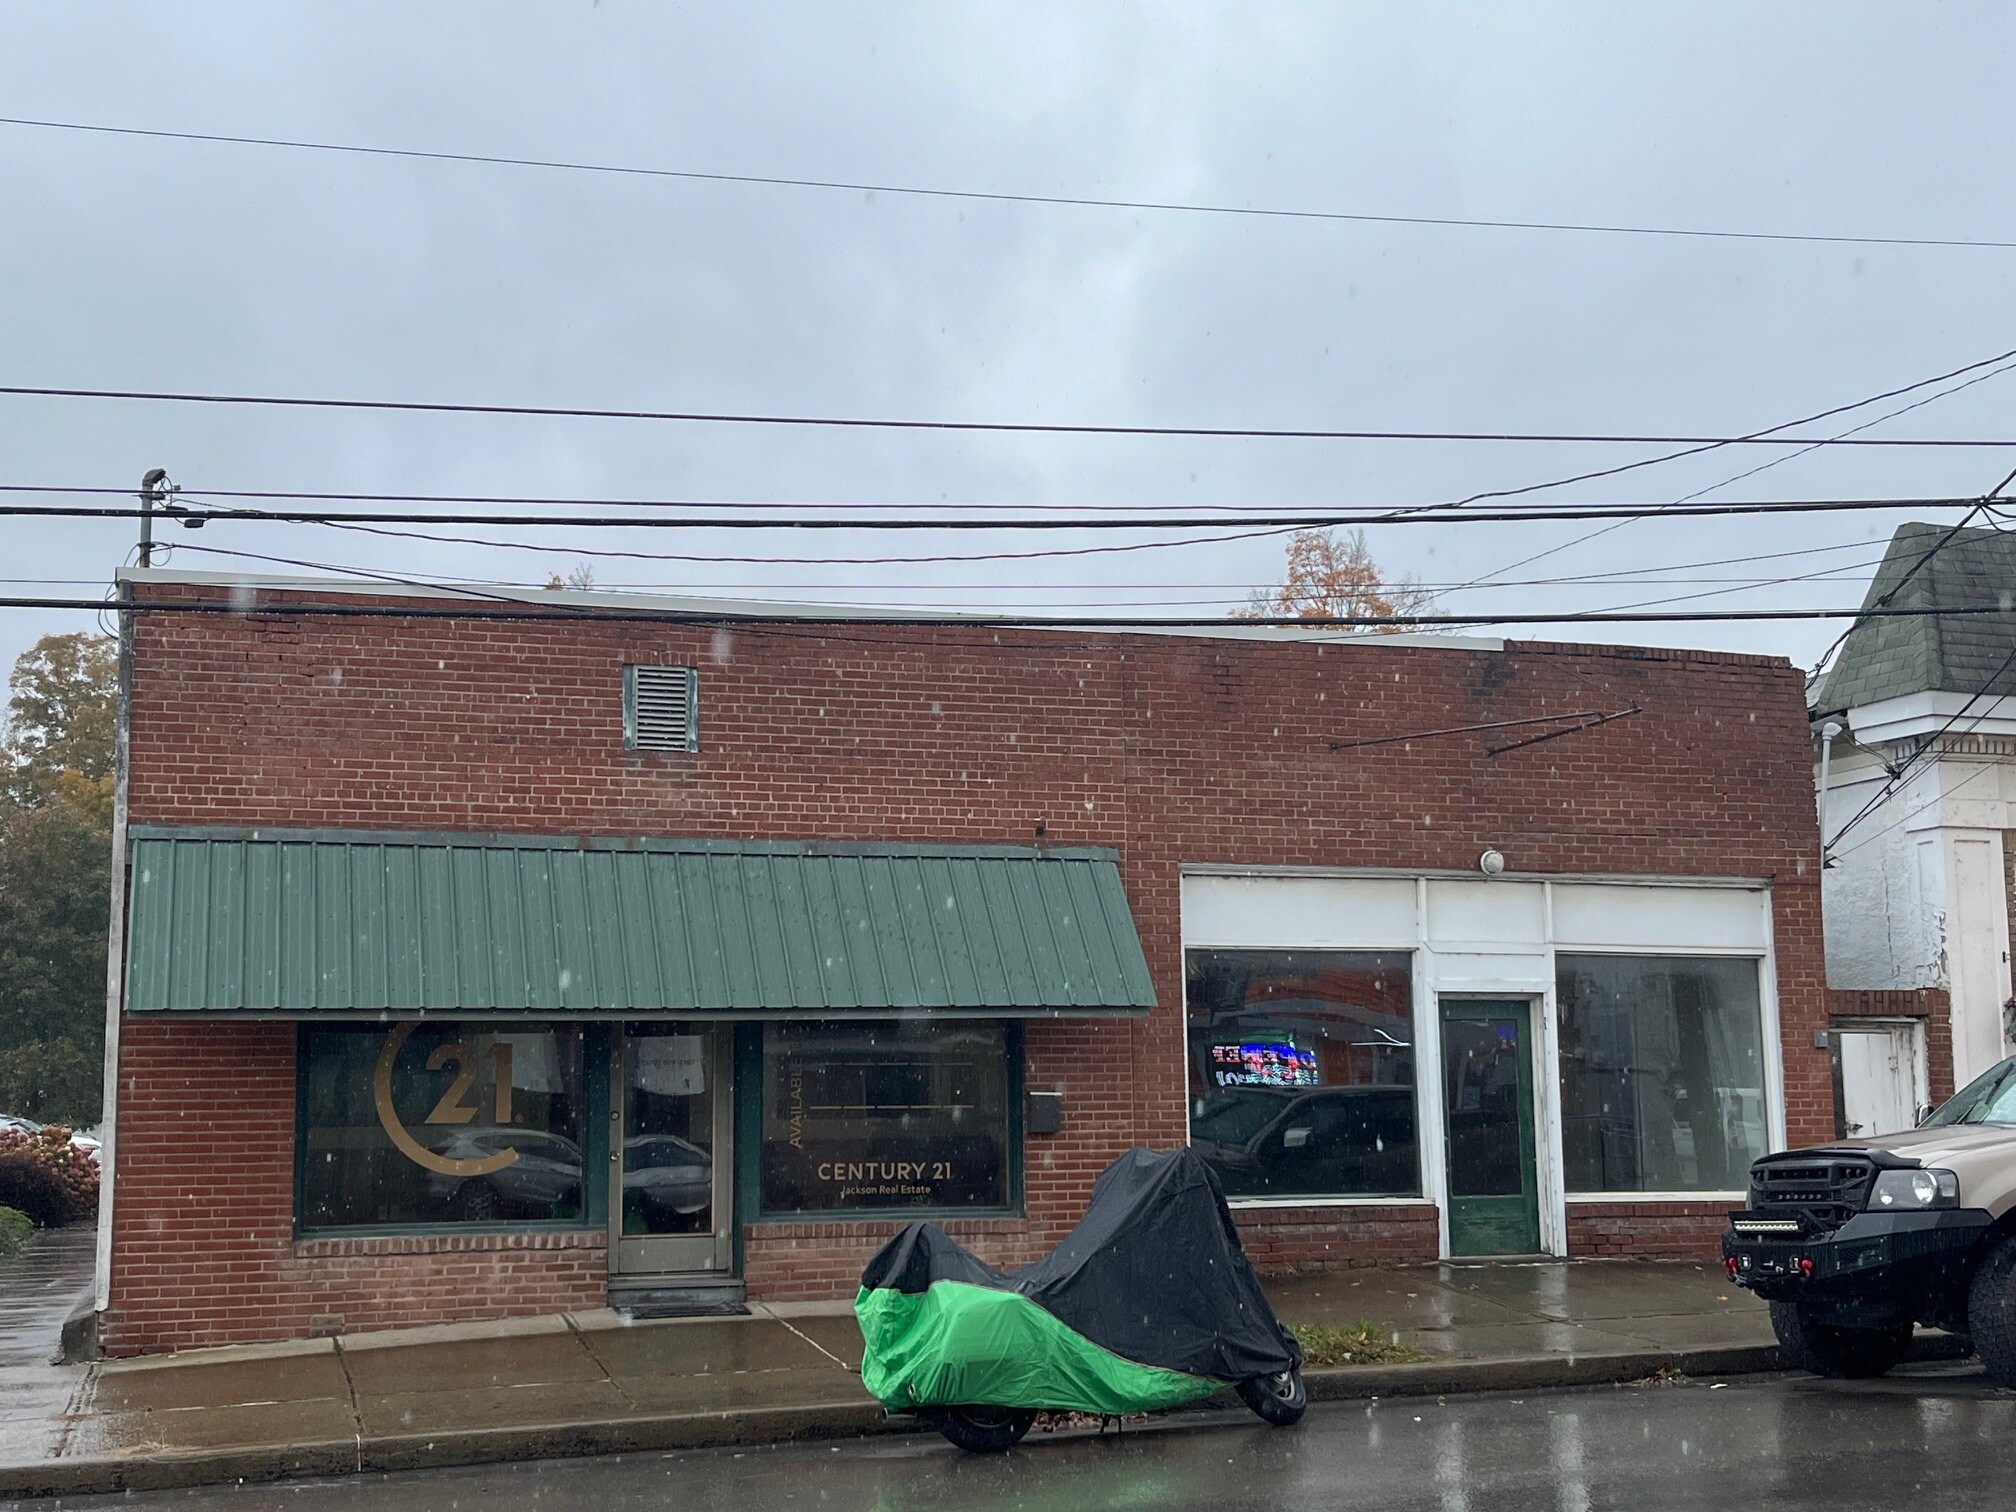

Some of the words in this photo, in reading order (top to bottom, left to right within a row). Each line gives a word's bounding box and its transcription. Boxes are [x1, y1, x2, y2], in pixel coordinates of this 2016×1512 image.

[424, 1042, 513, 1124] 21
[789, 1057, 803, 1149] AVAILABLE
[817, 1162, 926, 1181] CENTURY
[932, 1162, 952, 1180] 21
[840, 1185, 877, 1195] Jackson
[879, 1185, 899, 1195] Real
[901, 1184, 931, 1194] Estate
